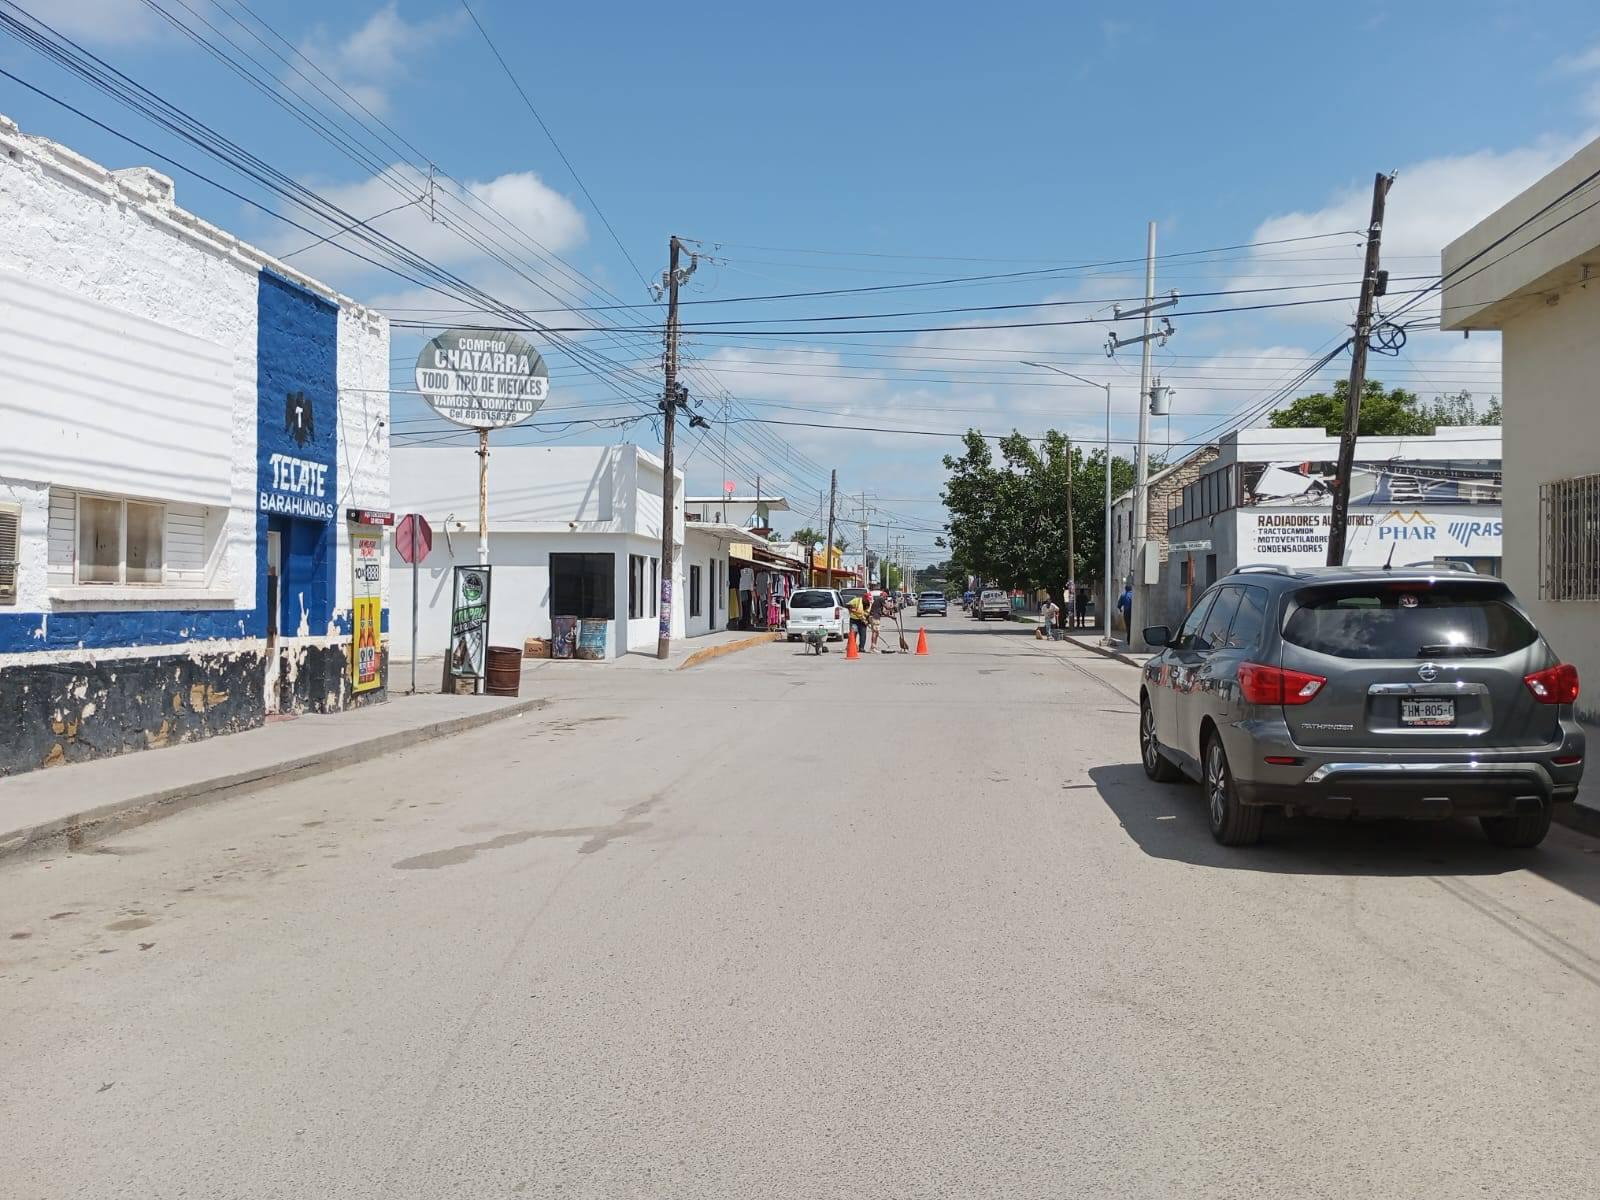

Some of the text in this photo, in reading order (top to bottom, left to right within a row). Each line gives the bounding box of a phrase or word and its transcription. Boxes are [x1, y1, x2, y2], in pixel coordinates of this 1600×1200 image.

[458, 337, 506, 353] COMPRO
[434, 348, 530, 375] CHATARRA
[422, 371, 542, 396] TODO TIPO DE METALES
[433, 395, 533, 412] VAMOS A DOMICILIO
[449, 409, 463, 419] Cel
[269, 453, 329, 497] TECATE
[259, 491, 334, 518] BARAHUNDAS
[1257, 515, 1320, 527] RADIADORES
[1257, 535, 1330, 543] MOTOVENTILADORE
[1379, 526, 1436, 540] PHAR
[1257, 544, 1323, 553] CONDENSADORES
